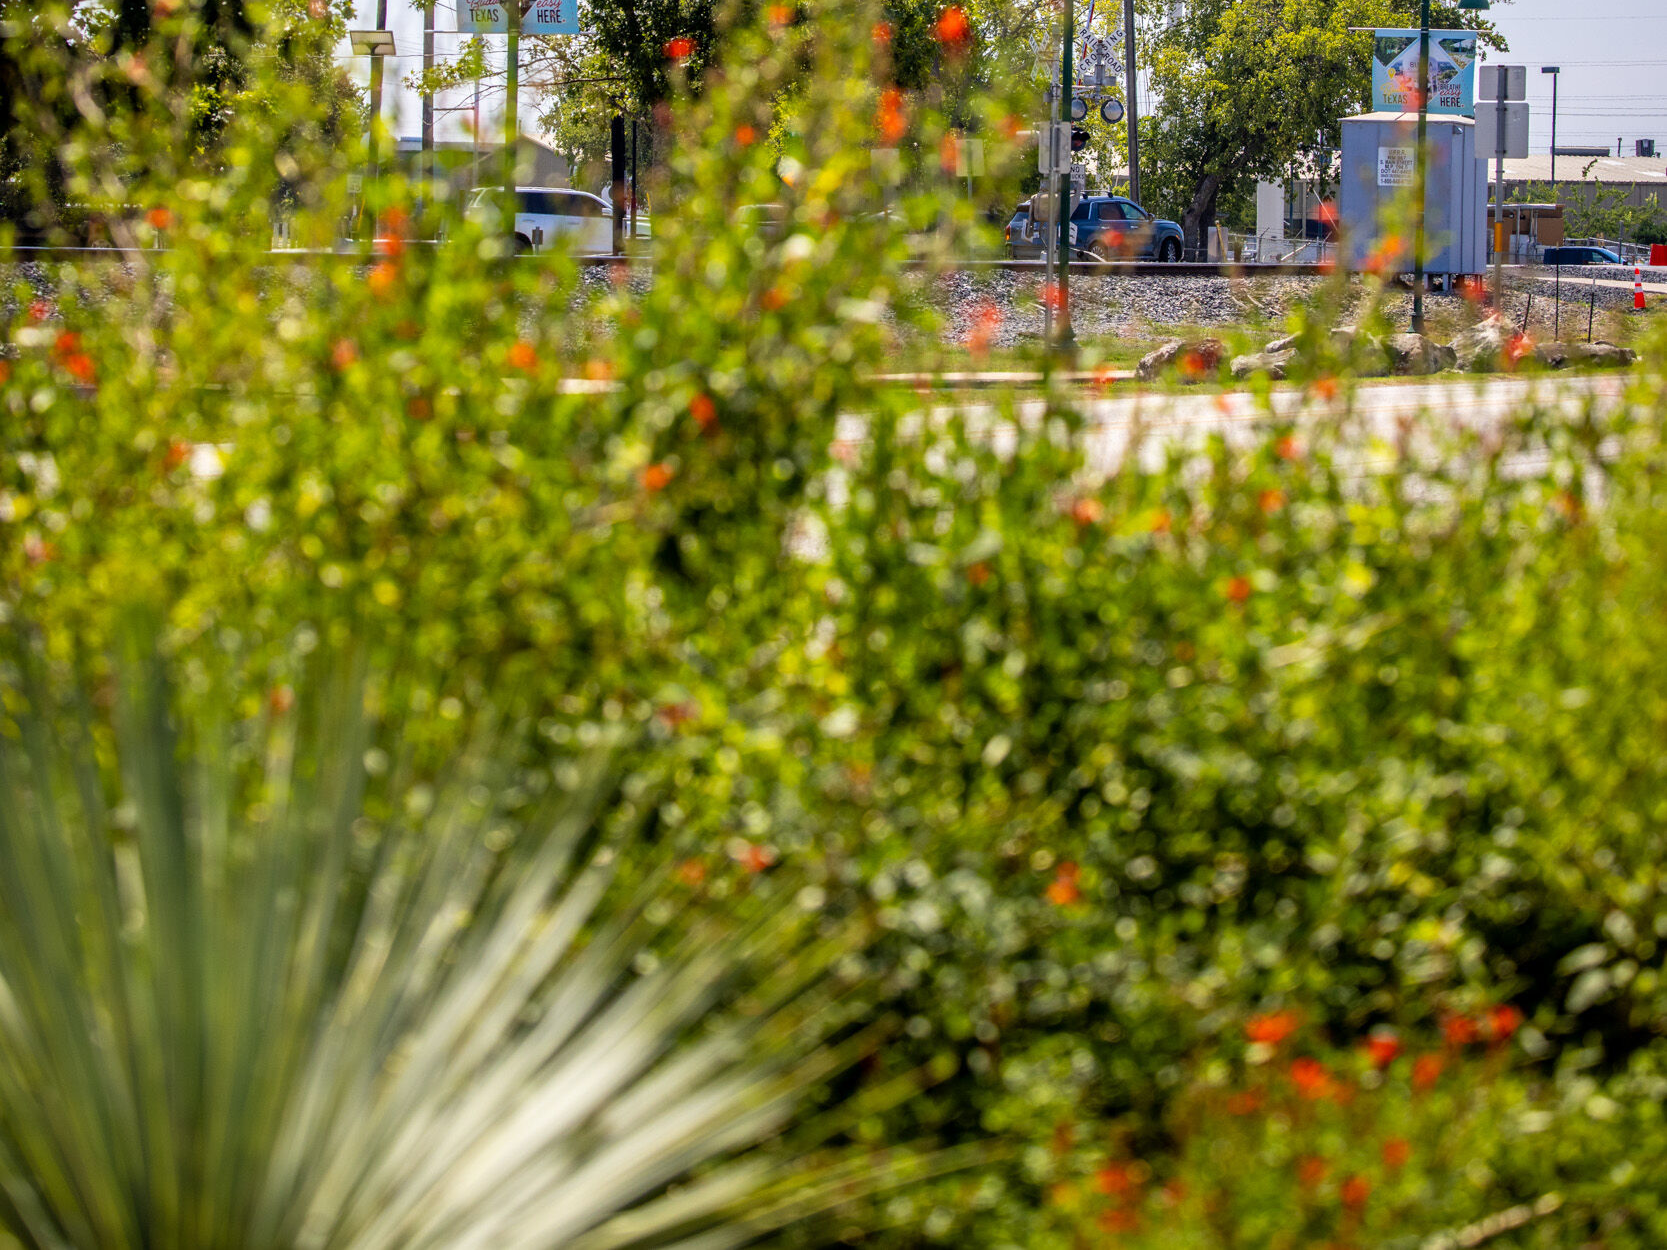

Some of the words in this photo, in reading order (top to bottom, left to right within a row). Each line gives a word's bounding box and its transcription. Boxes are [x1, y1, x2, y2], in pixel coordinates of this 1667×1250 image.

[469, 8, 499, 22] TEXAS
[537, 10, 566, 23] HERE.
[1382, 93, 1408, 104] TEXAS
[1440, 97, 1464, 108] HERE.
